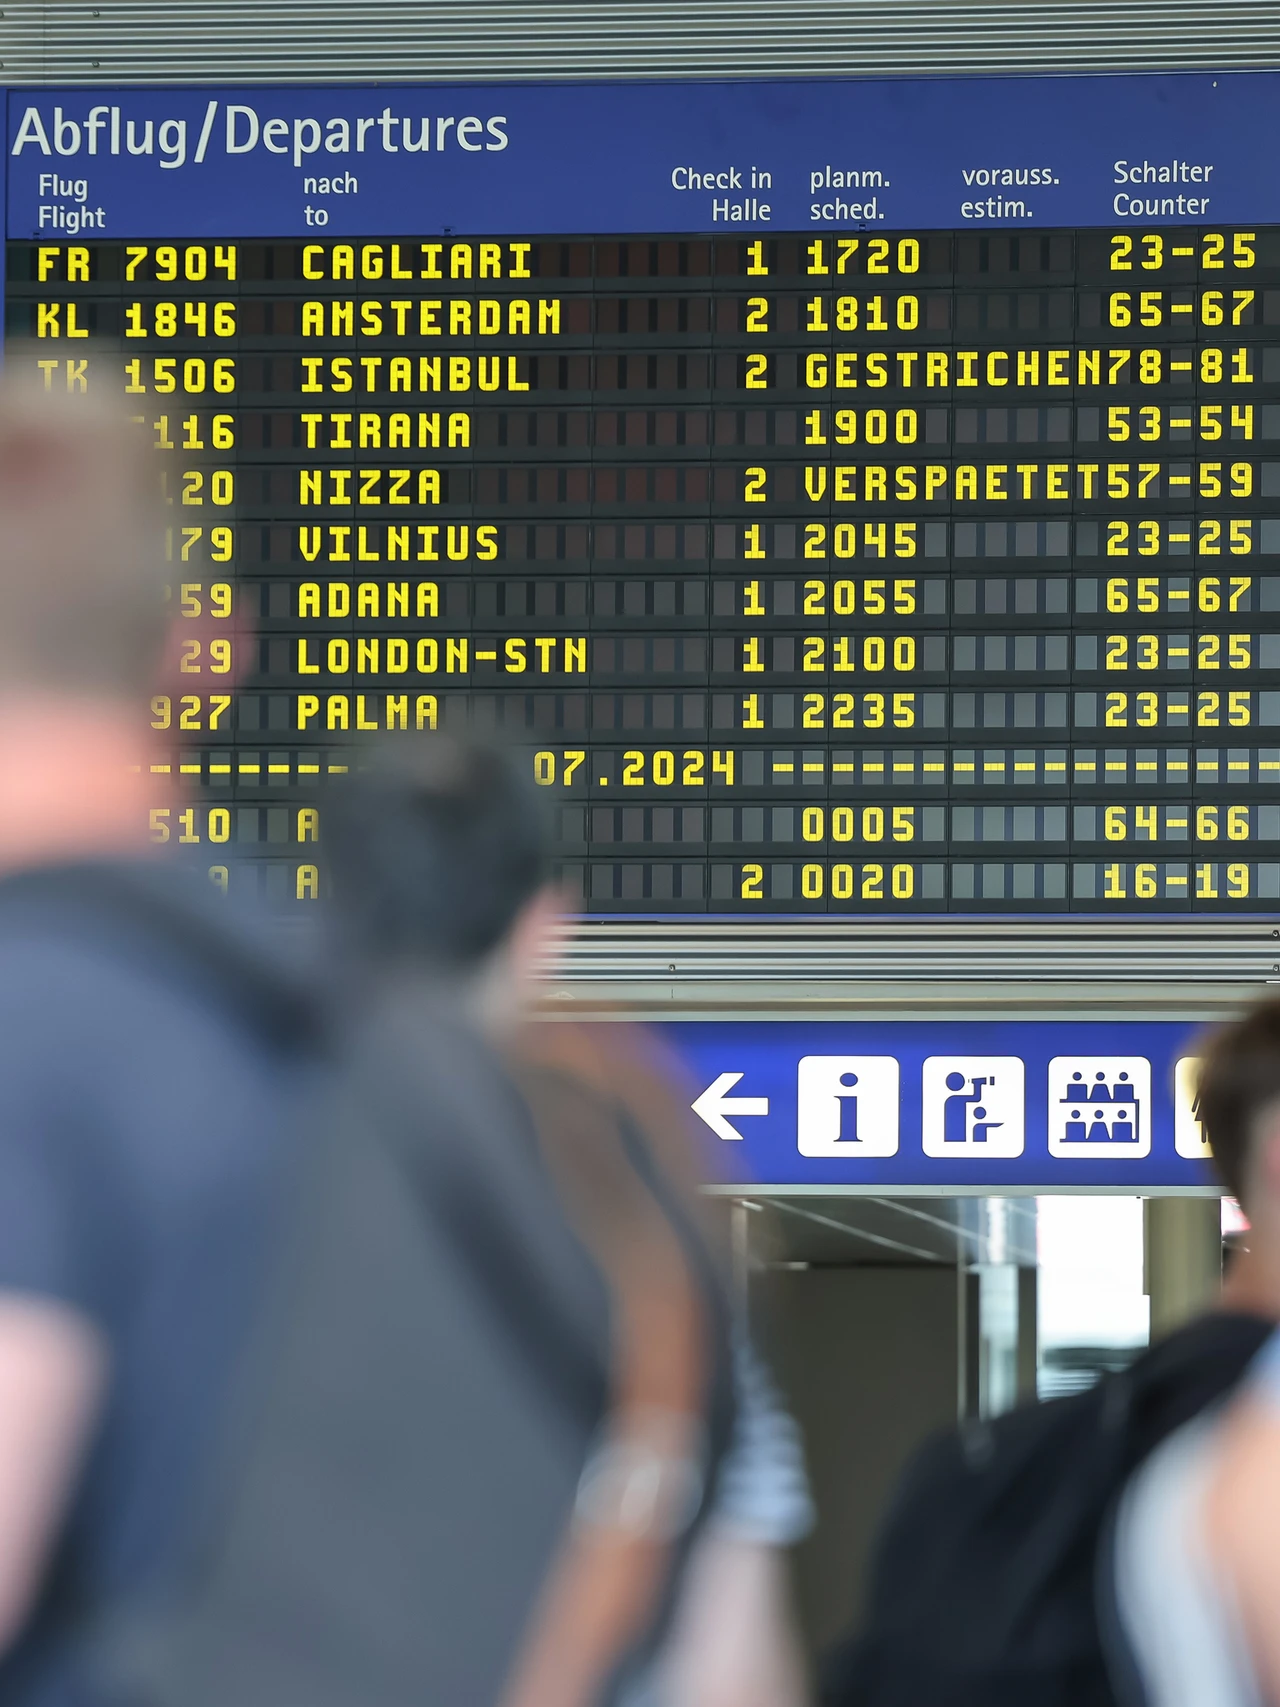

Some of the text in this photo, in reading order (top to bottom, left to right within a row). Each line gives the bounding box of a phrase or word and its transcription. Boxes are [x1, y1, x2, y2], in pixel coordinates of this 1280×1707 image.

[11, 99, 510, 169] Abflug/Departures
[39, 174, 88, 202] Flug
[304, 171, 358, 194] nach
[671, 166, 772, 190] Check in
[810, 165, 890, 195] planm.
[962, 165, 1060, 186] vorauss.
[1113, 159, 1214, 184] Schalter
[38, 205, 106, 235] Flight
[303, 205, 329, 226] to
[712, 198, 771, 222] Halle
[810, 194, 885, 220] sched.
[961, 195, 1033, 218] estim.
[1113, 193, 1210, 216] Counter
[38, 235, 1256, 282] FR 7904 CAGLIARI 1 1720 23-25
[37, 292, 1255, 338] KL 1846 AMSTERDAM 2 1810 65-67
[37, 359, 89, 394] TK
[125, 359, 235, 393] 1506
[302, 357, 530, 392] ISTANBUL
[745, 354, 767, 388] 2
[131, 406, 1253, 449] 116 TIRANA 1900 53-54
[301, 470, 440, 504] NIZZA
[744, 468, 766, 502] 2
[166, 521, 1252, 562] 79 VILNIUS 1 2045 23-25
[166, 578, 1252, 618] 59 ADANA 1 2055 65-67
[299, 639, 586, 673] LONDON-STN
[743, 638, 765, 672] 1
[804, 636, 916, 672] 2100
[1107, 635, 1251, 669] 23-25
[298, 696, 438, 730] PALMA
[742, 695, 764, 729] 1
[803, 693, 915, 729] 2235
[1106, 692, 1251, 726] 23-25
[802, 806, 914, 842] 0005
[1105, 807, 1249, 841] 64-66
[741, 863, 1249, 899] 2 0020 16-19
